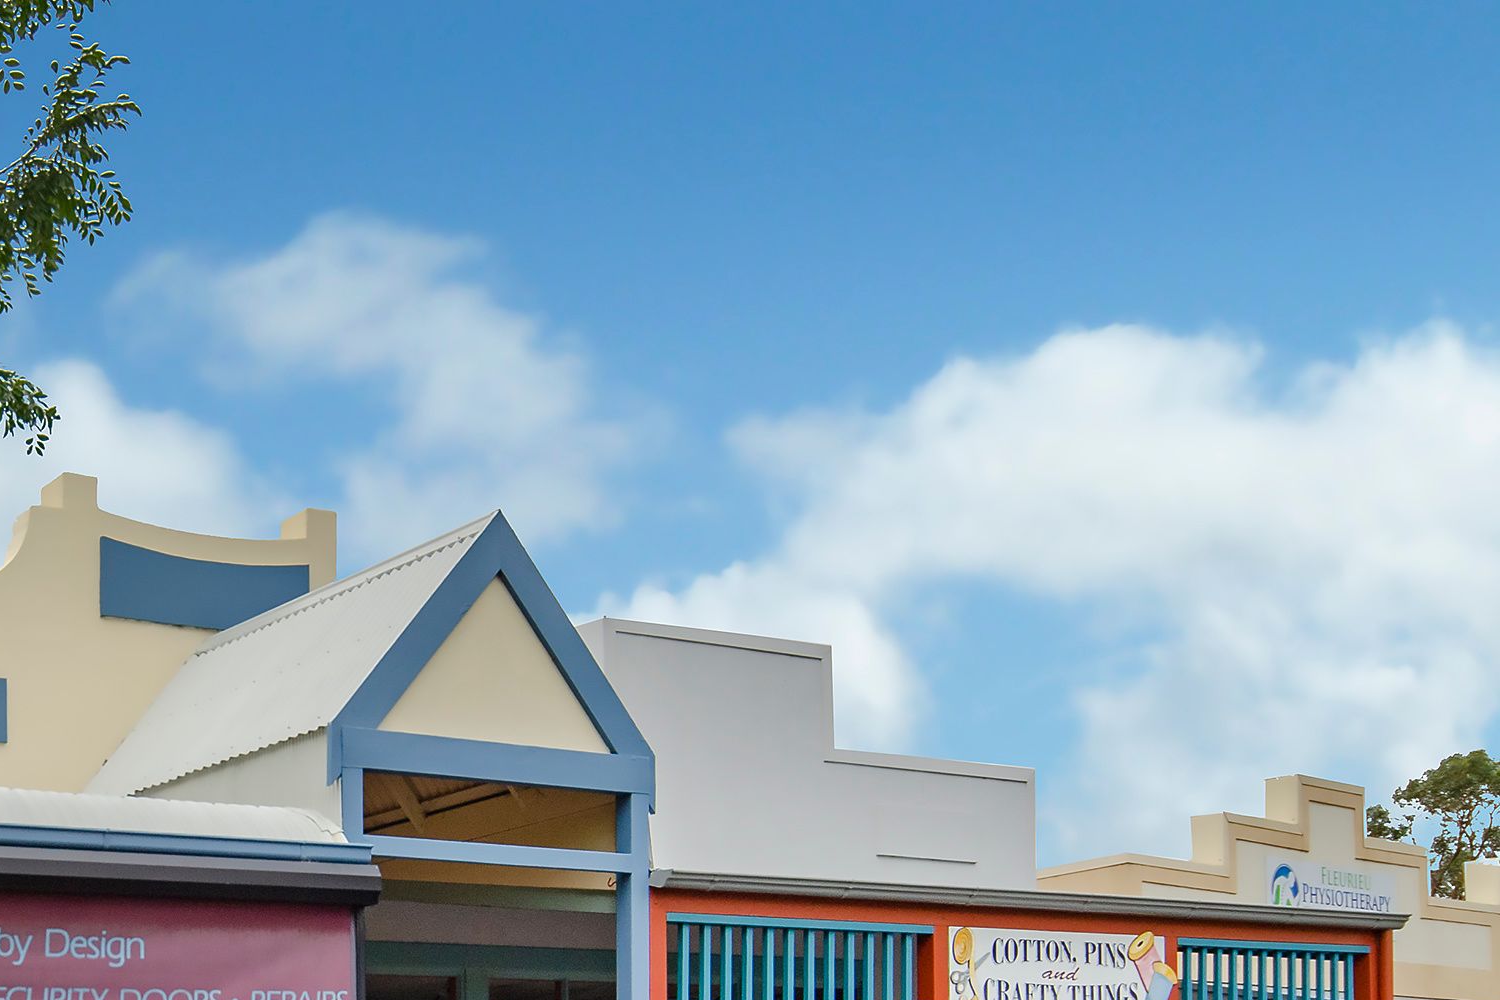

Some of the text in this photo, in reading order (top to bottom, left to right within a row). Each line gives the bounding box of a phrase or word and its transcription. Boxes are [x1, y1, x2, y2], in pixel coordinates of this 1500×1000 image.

[1321, 866, 1372, 891] FLEURIEU
[1302, 882, 1391, 912] PHYSIOTHERAPY
[44, 928, 145, 968] Design
[1085, 941, 1126, 969] PINS
[1041, 967, 1080, 981] and
